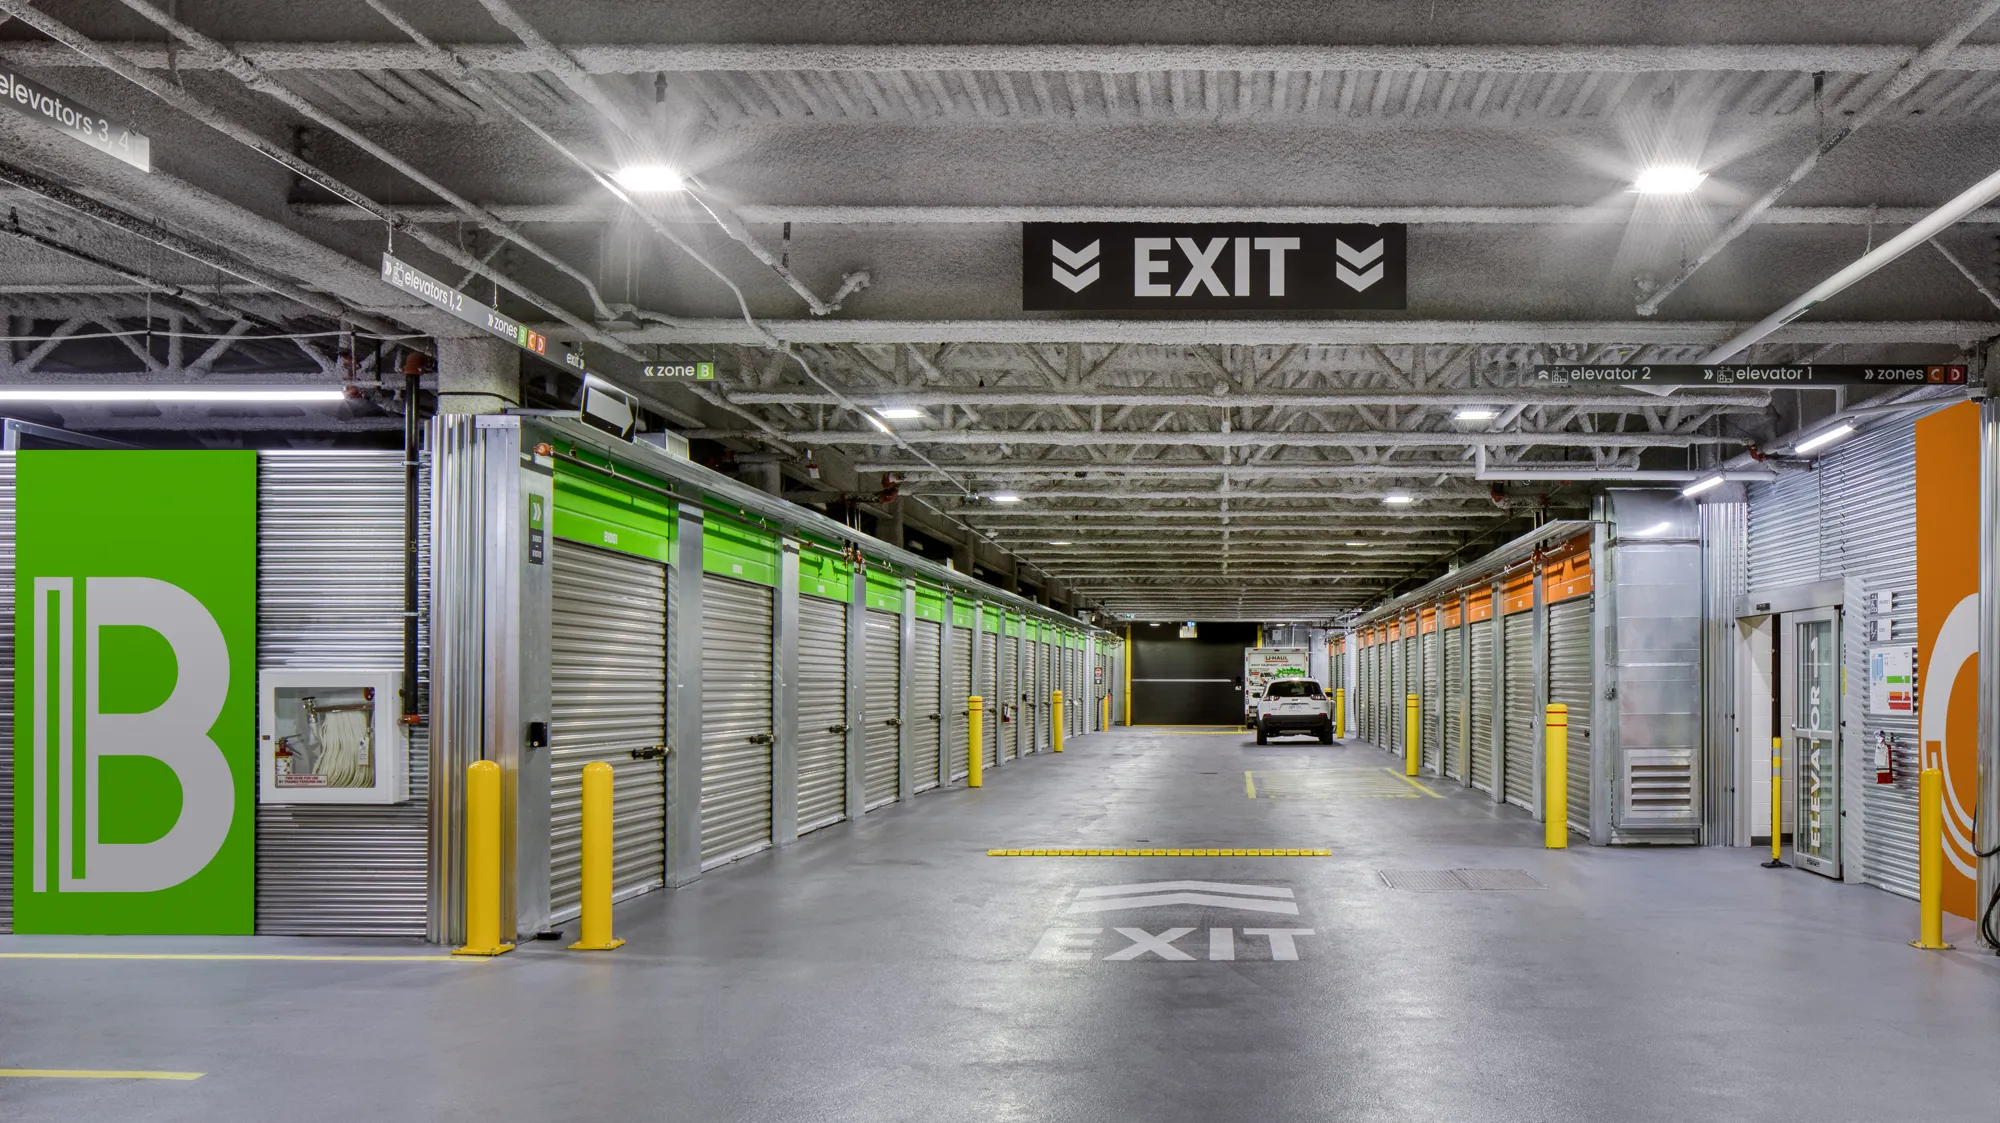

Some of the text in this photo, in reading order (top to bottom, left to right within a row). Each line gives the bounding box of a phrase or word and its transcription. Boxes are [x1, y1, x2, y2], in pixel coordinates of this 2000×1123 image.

[0, 74, 130, 152] elevators 3, 4
[1134, 237, 1300, 297] EXIT
[404, 270, 448, 305] elevators
[456, 294, 464, 312] 2
[494, 316, 543, 352] zones B C D
[566, 352, 579, 368] exit
[656, 364, 710, 378] zone B
[1570, 366, 1651, 380] elevator 2
[1736, 366, 1813, 380] elevator 1
[1877, 368, 1961, 381] zones C D
[1810, 636, 1819, 678] 1
[33, 576, 235, 893] B
[1810, 685, 1821, 848] ELEVATOR
[1028, 927, 1316, 961] EXIT
